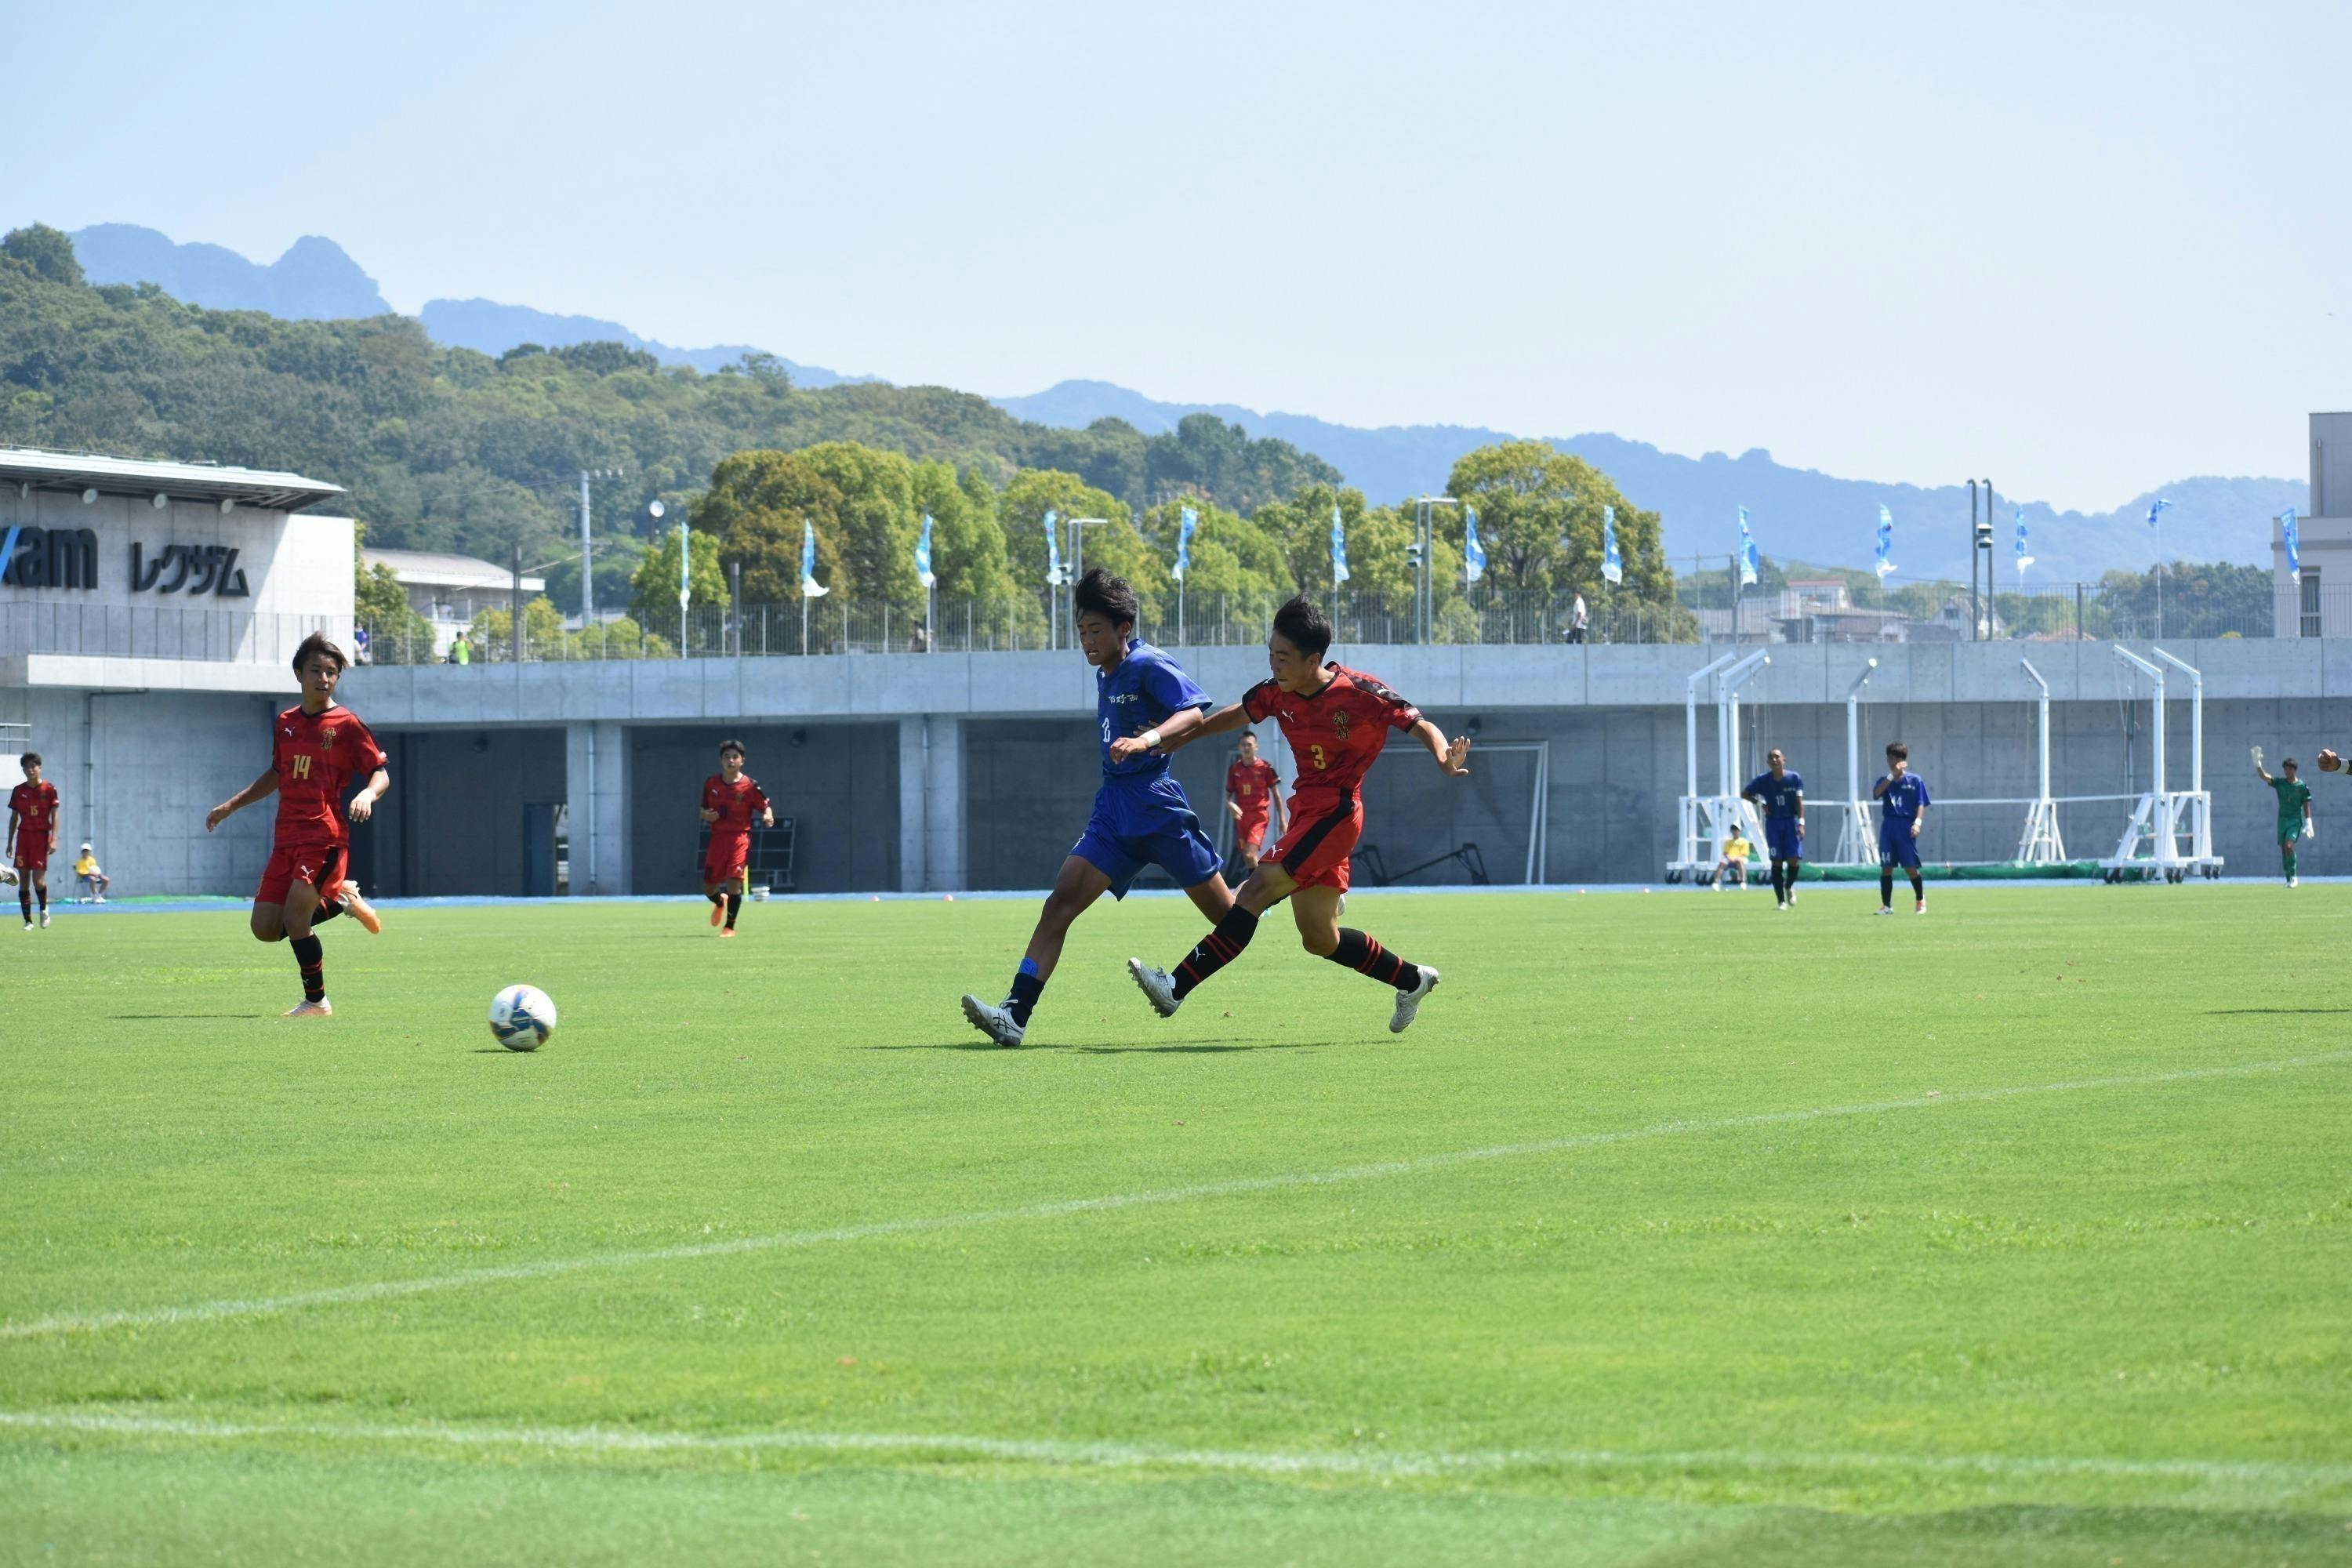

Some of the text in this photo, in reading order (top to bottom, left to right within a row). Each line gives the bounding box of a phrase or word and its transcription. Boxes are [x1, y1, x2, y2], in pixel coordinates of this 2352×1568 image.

[131, 542, 250, 597] レクザム
[1102, 717, 1111, 742] 2
[292, 754, 312, 780] 14
[1311, 744, 1326, 769] 3
[31, 805, 38, 816] 15
[1775, 795, 1785, 806] 10
